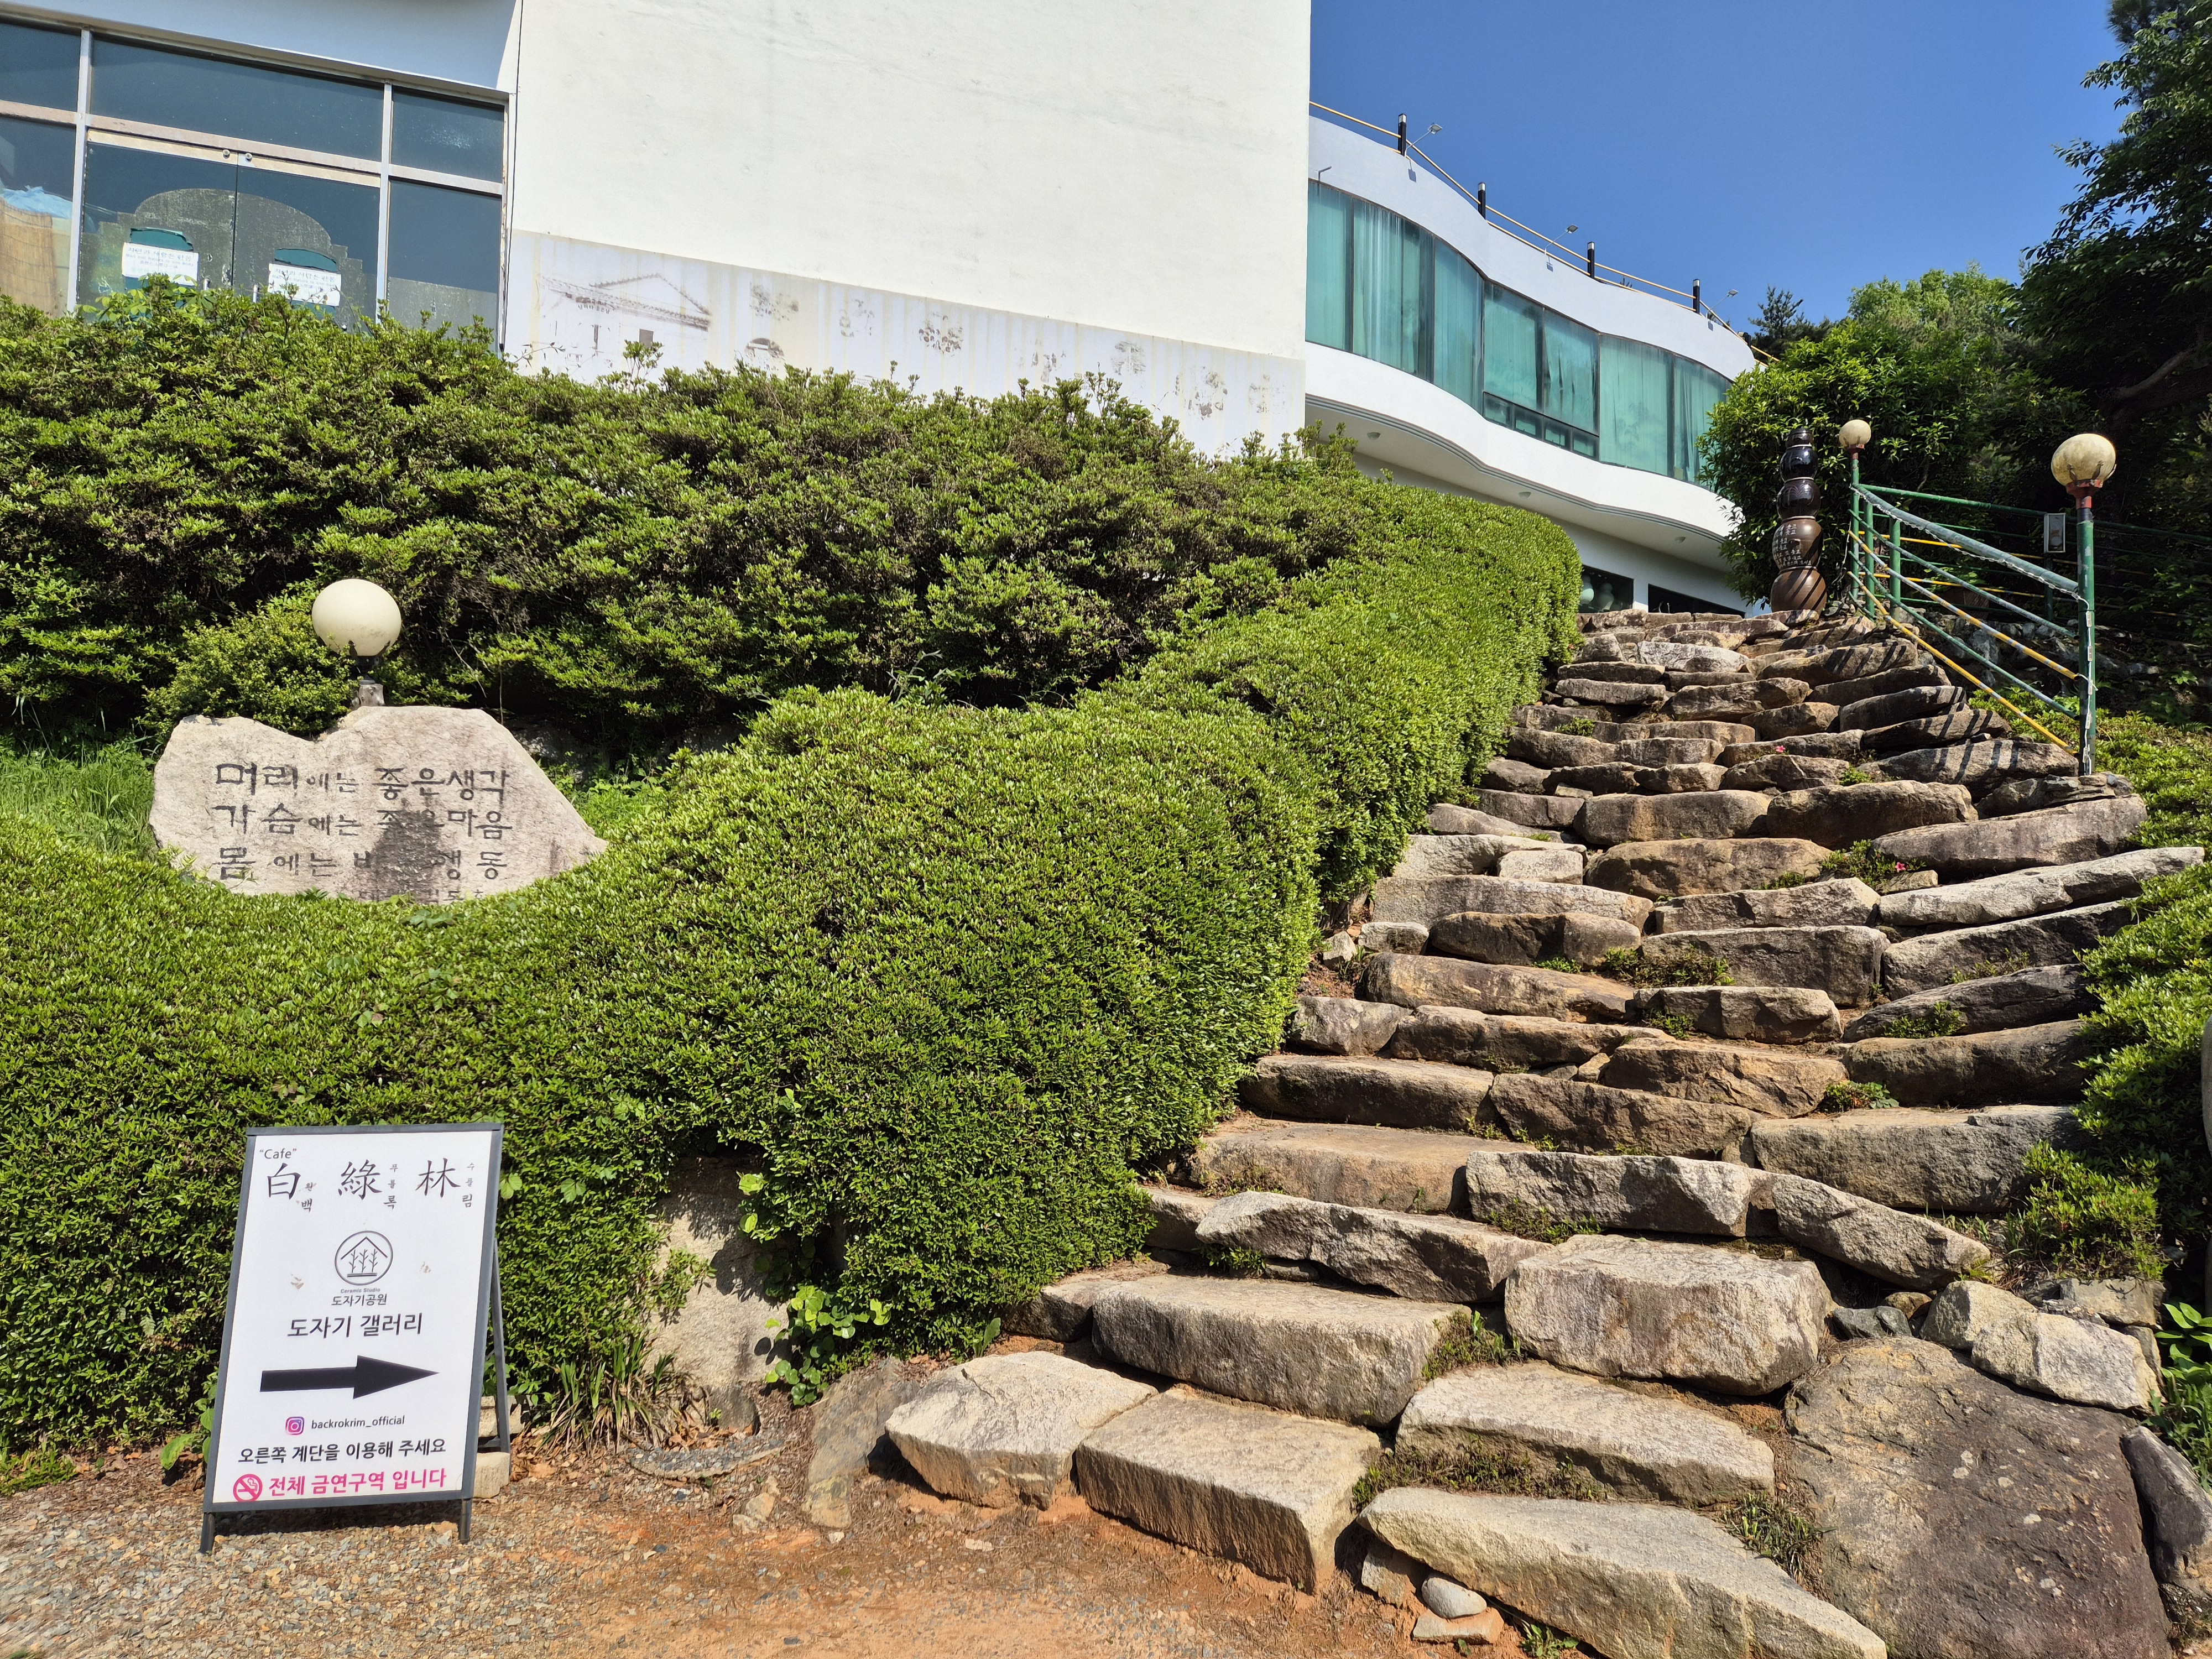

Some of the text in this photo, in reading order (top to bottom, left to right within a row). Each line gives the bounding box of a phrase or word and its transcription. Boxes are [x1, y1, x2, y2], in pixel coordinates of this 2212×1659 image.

[301, 1198, 313, 1213] 백
[383, 1195, 397, 1210] 록
[462, 1193, 473, 1208] 림
[331, 1293, 388, 1307] 도자기공원
[287, 1313, 422, 1339] 도자기 갤러리
[311, 1415, 405, 1429] backrokrim_official
[238, 1438, 446, 1464] 오른쪽 계단을 이용해 주세요
[269, 1468, 447, 1496] 전체 금연구역 입니다
